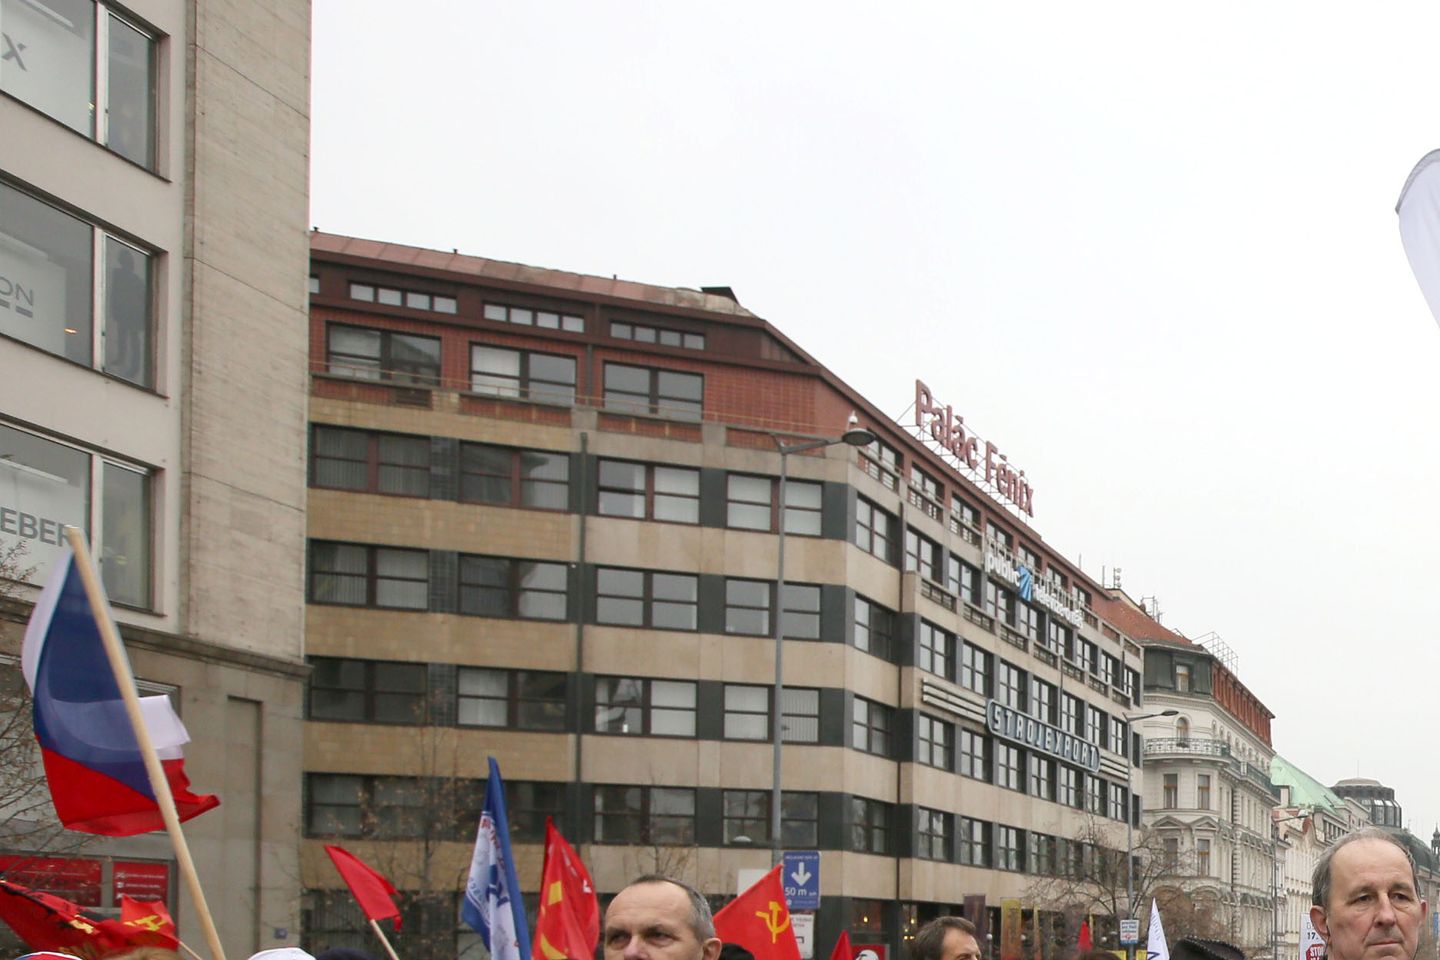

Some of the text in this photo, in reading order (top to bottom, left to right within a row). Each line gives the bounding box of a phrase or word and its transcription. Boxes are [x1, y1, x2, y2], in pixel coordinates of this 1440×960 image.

[916, 379, 1034, 518] Palác Fénix
[994, 706, 1096, 768] STROJEXPORT
